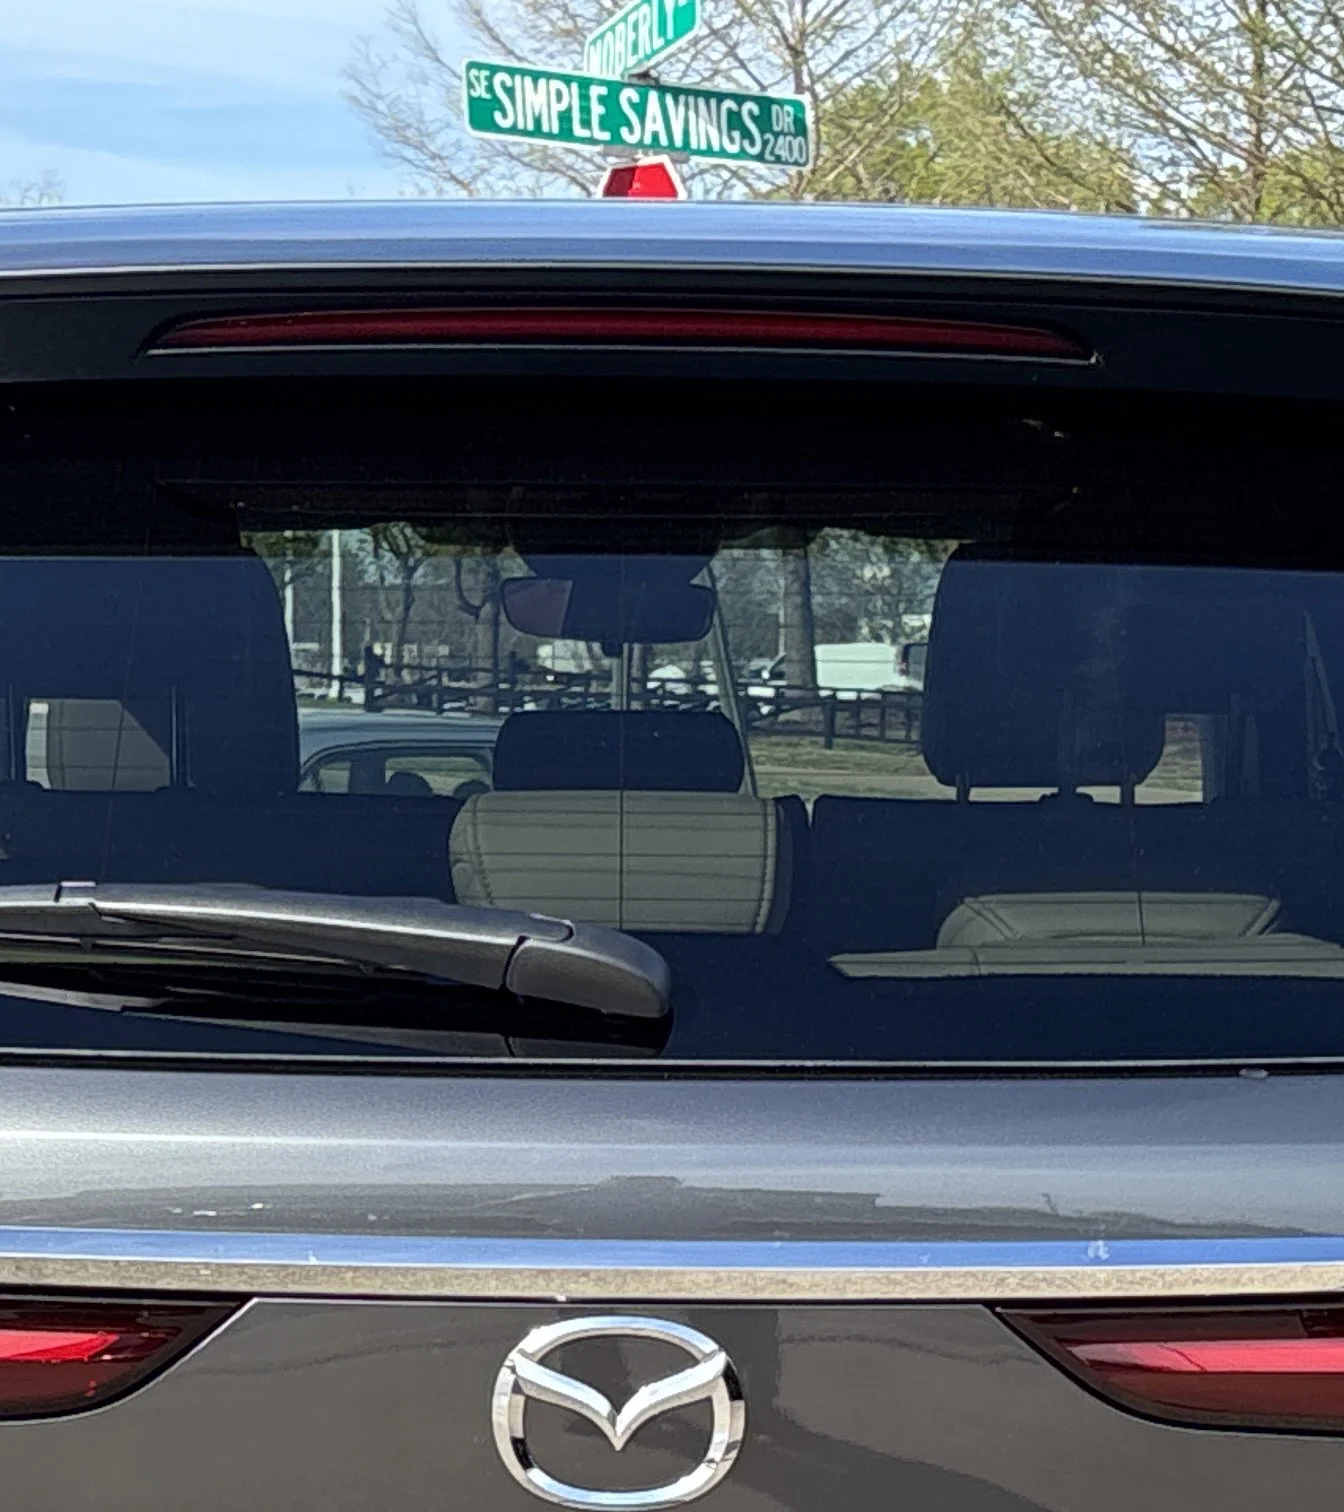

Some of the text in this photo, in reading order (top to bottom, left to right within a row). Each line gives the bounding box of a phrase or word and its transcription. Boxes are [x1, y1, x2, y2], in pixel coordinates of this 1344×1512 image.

[469, 69, 796, 155] SE SIMPLE SAVINGS DR
[763, 135, 807, 164] 2400
